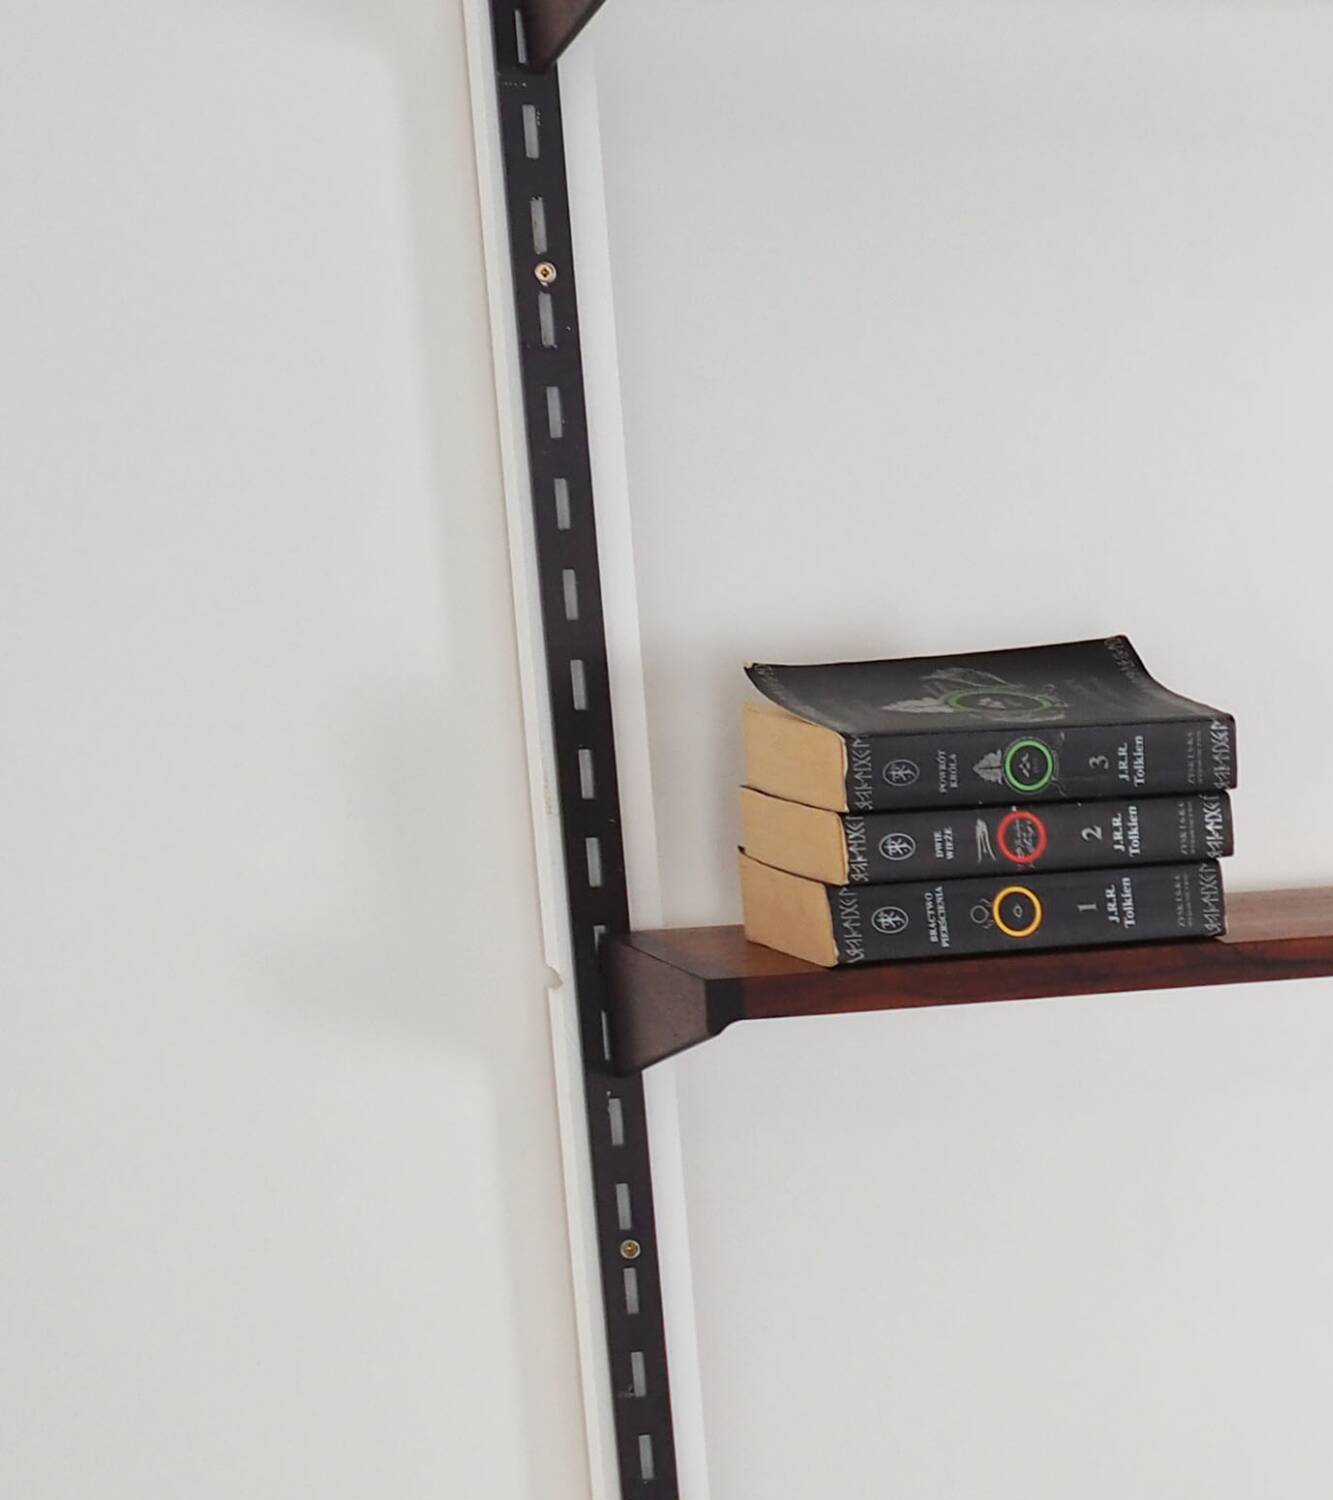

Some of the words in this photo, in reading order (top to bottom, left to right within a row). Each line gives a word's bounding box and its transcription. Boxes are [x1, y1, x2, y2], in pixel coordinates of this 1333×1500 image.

[938, 750, 947, 793] POWRÓT
[949, 753, 958, 788] KRÓLA
[1089, 755, 1109, 769] 3
[1118, 742, 1129, 782] J.R.R.
[1133, 736, 1145, 787] Tolkien
[934, 831, 944, 858] DWIE
[944, 827, 954, 860] WIEŻE
[1081, 825, 1102, 841] 2
[1112, 813, 1125, 852] J.R.R.
[1128, 806, 1140, 857] Tolkien
[1077, 904, 1097, 912] 1
[1105, 884, 1120, 923] J.R.R.
[1121, 877, 1135, 929] Tolkien
